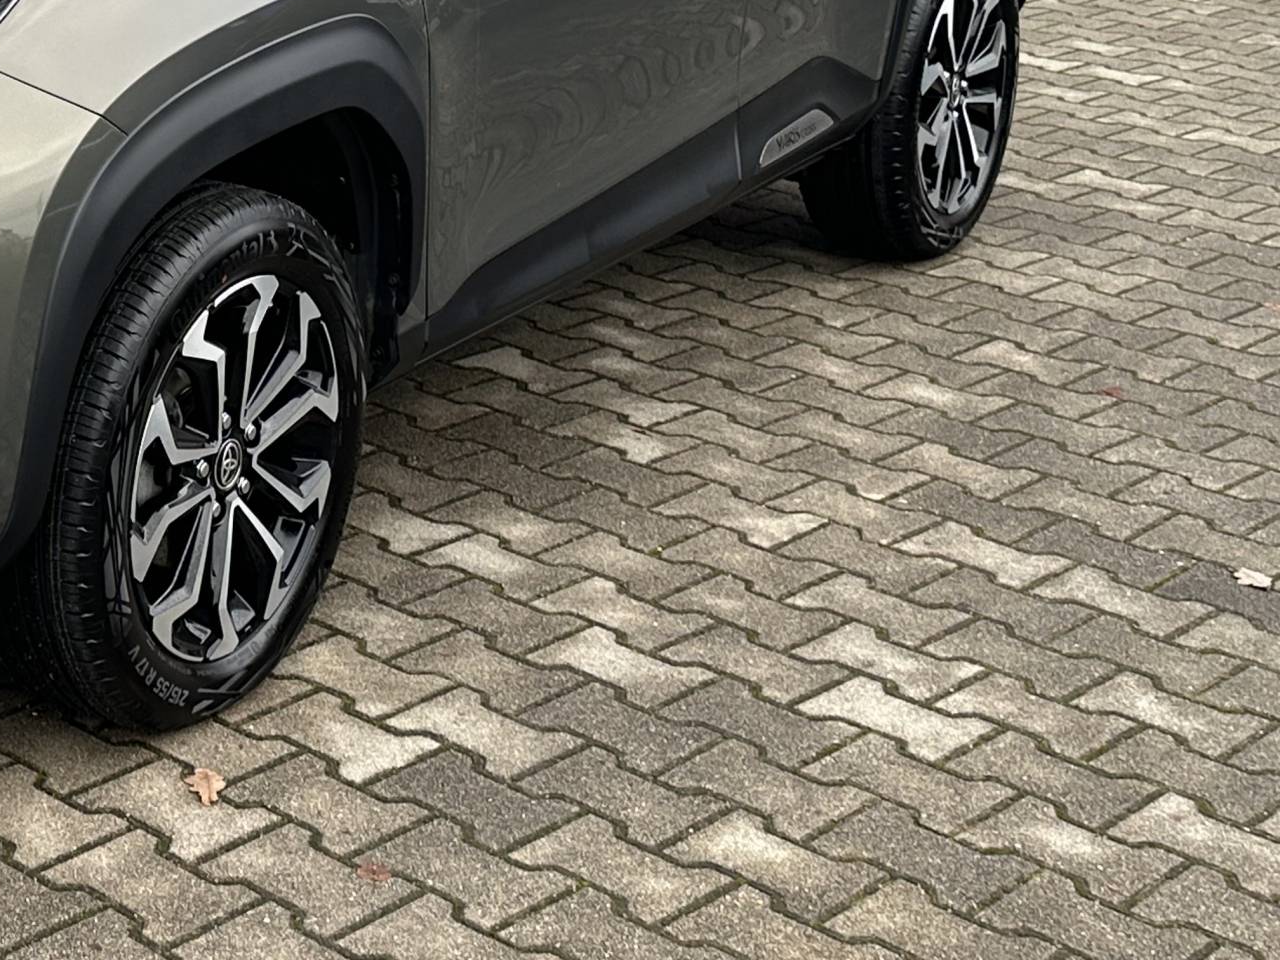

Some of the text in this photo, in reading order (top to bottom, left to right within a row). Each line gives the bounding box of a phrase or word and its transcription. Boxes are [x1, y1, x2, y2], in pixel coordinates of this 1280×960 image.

[127, 644, 190, 707] 215/55 R 17 V
